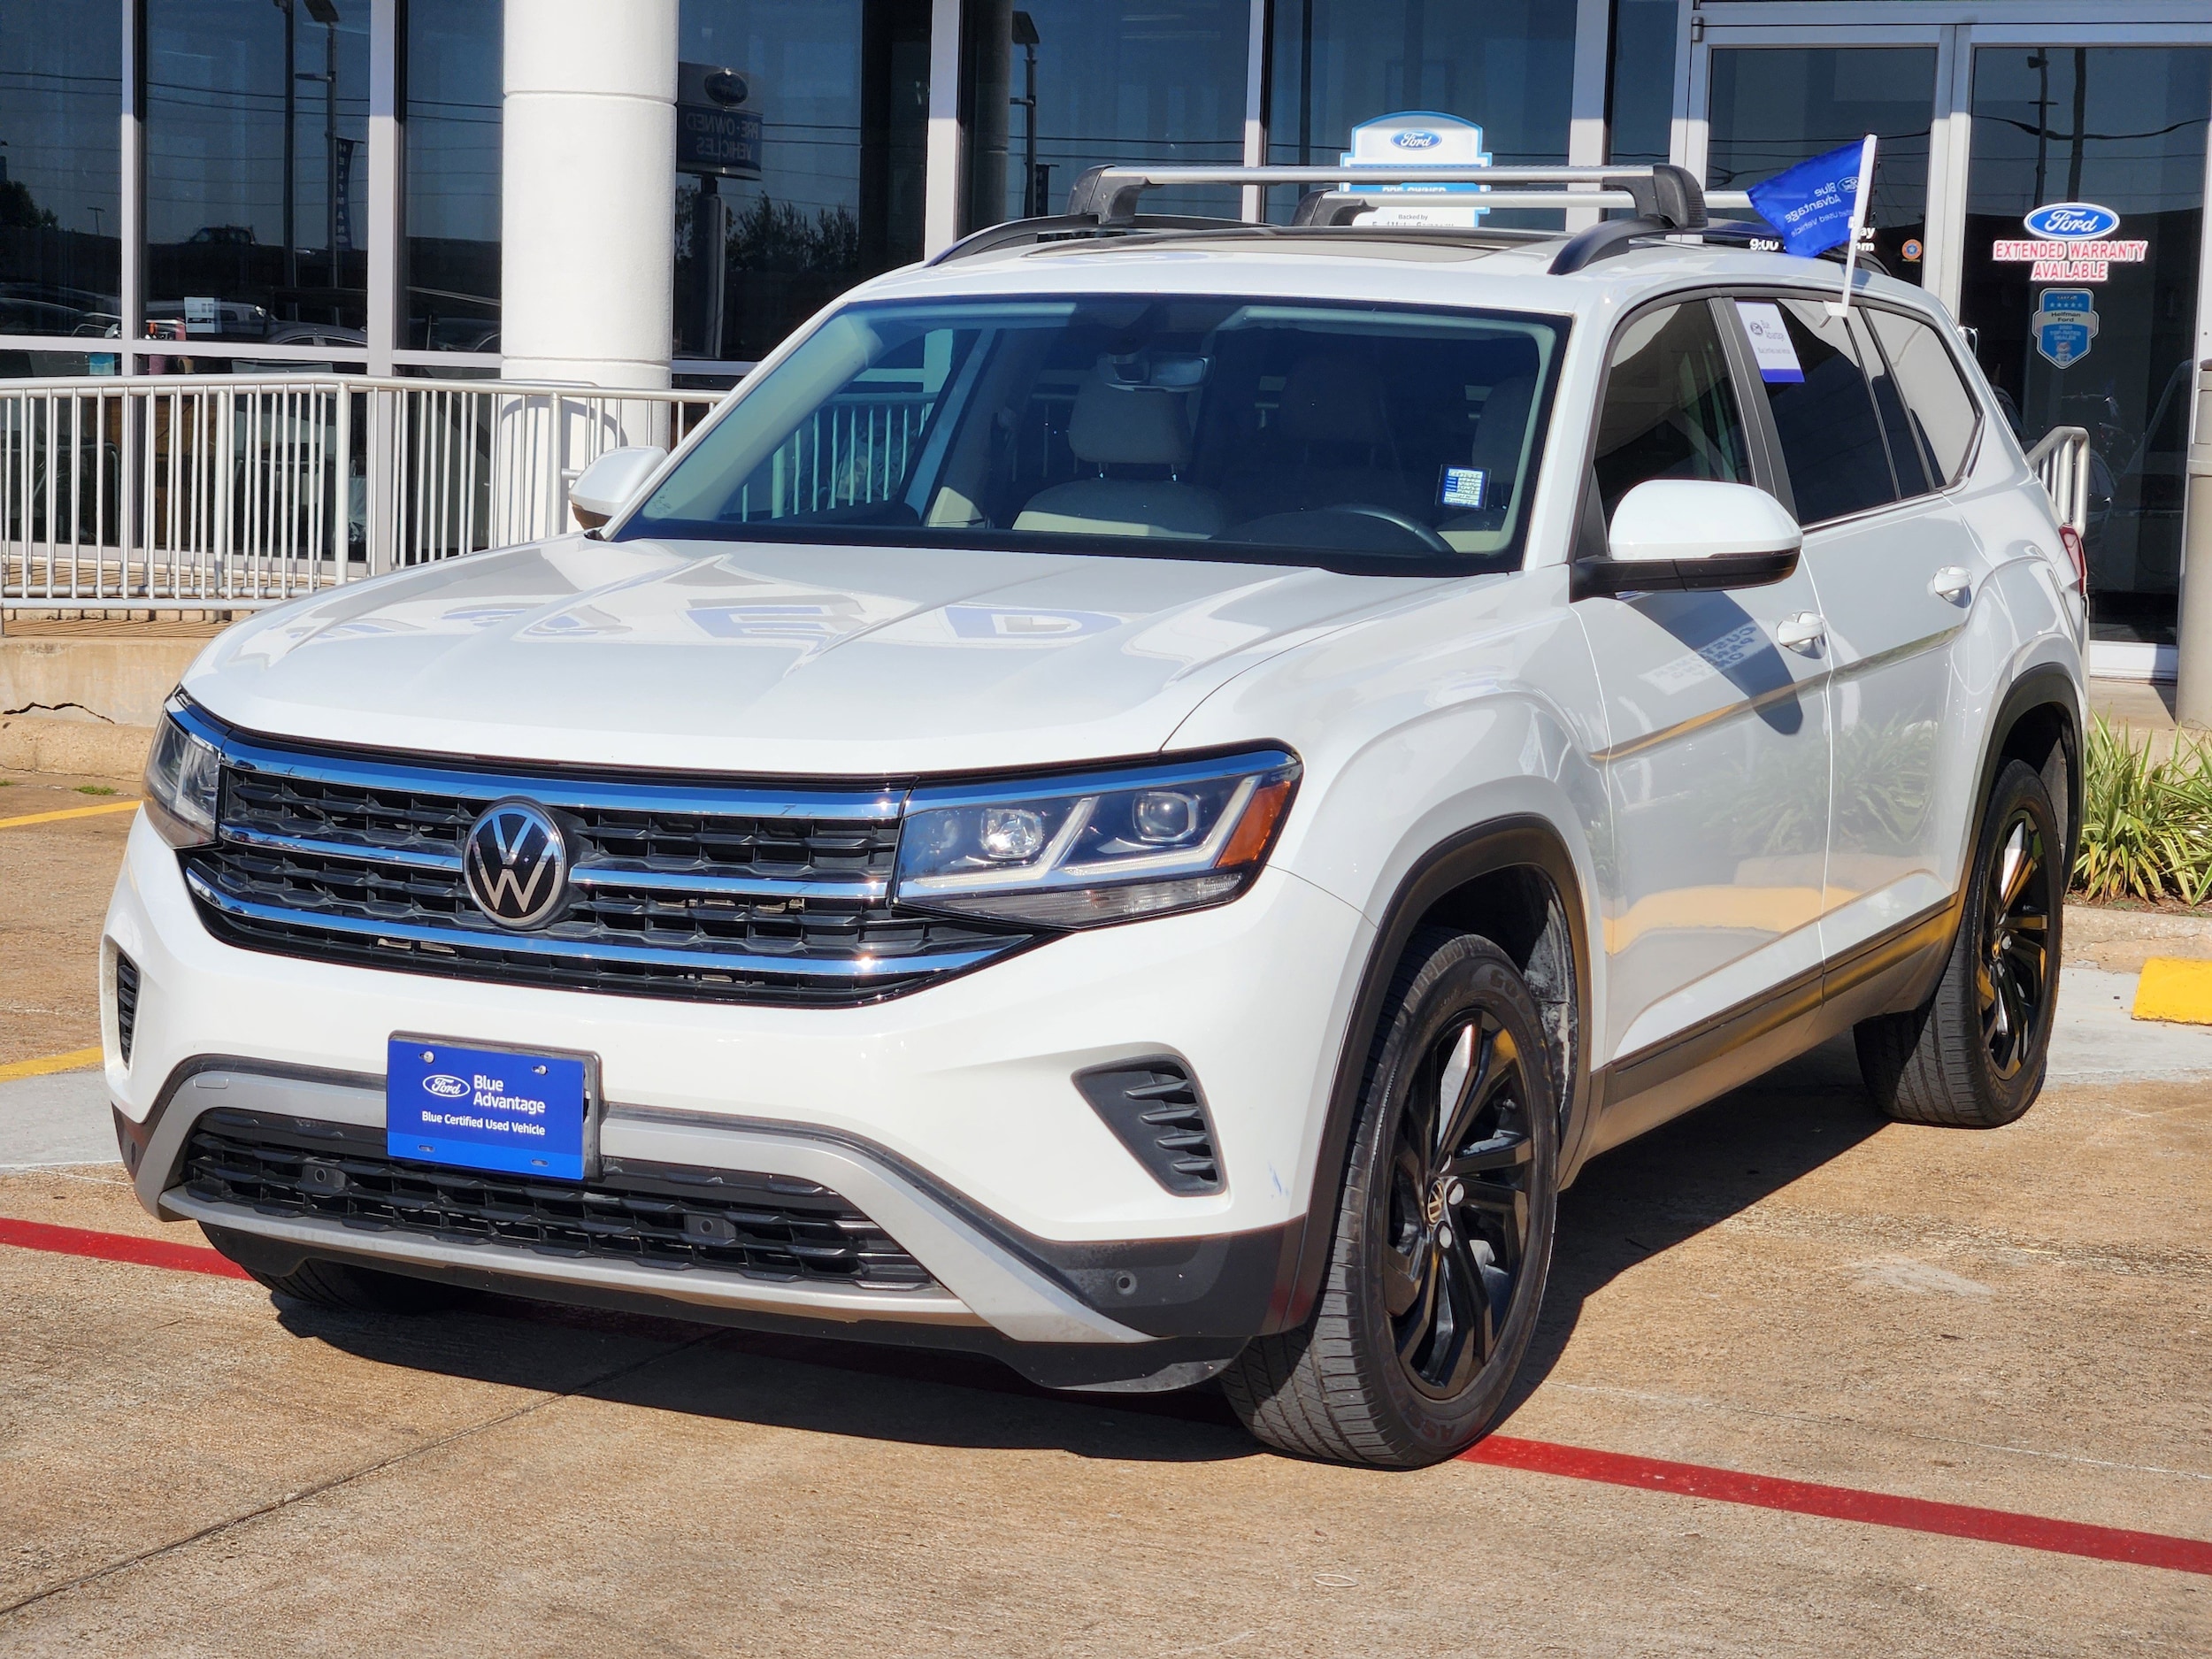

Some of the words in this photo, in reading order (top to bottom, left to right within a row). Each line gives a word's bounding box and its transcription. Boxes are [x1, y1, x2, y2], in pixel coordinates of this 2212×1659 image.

[1400, 132, 1432, 147] Ford
[2044, 209, 2100, 232] Ford
[1993, 241, 2066, 260] EXTENDED
[2068, 242, 2147, 261] WARRANTY
[2032, 262, 2108, 280] AVAILABLE
[431, 1076, 462, 1095] Ford
[472, 1074, 504, 1093] Blue
[472, 1092, 546, 1115] Advantage
[421, 1110, 443, 1124] Blue
[444, 1114, 483, 1129] Certified
[485, 1118, 510, 1133] Used
[511, 1122, 546, 1136] Vehicle
